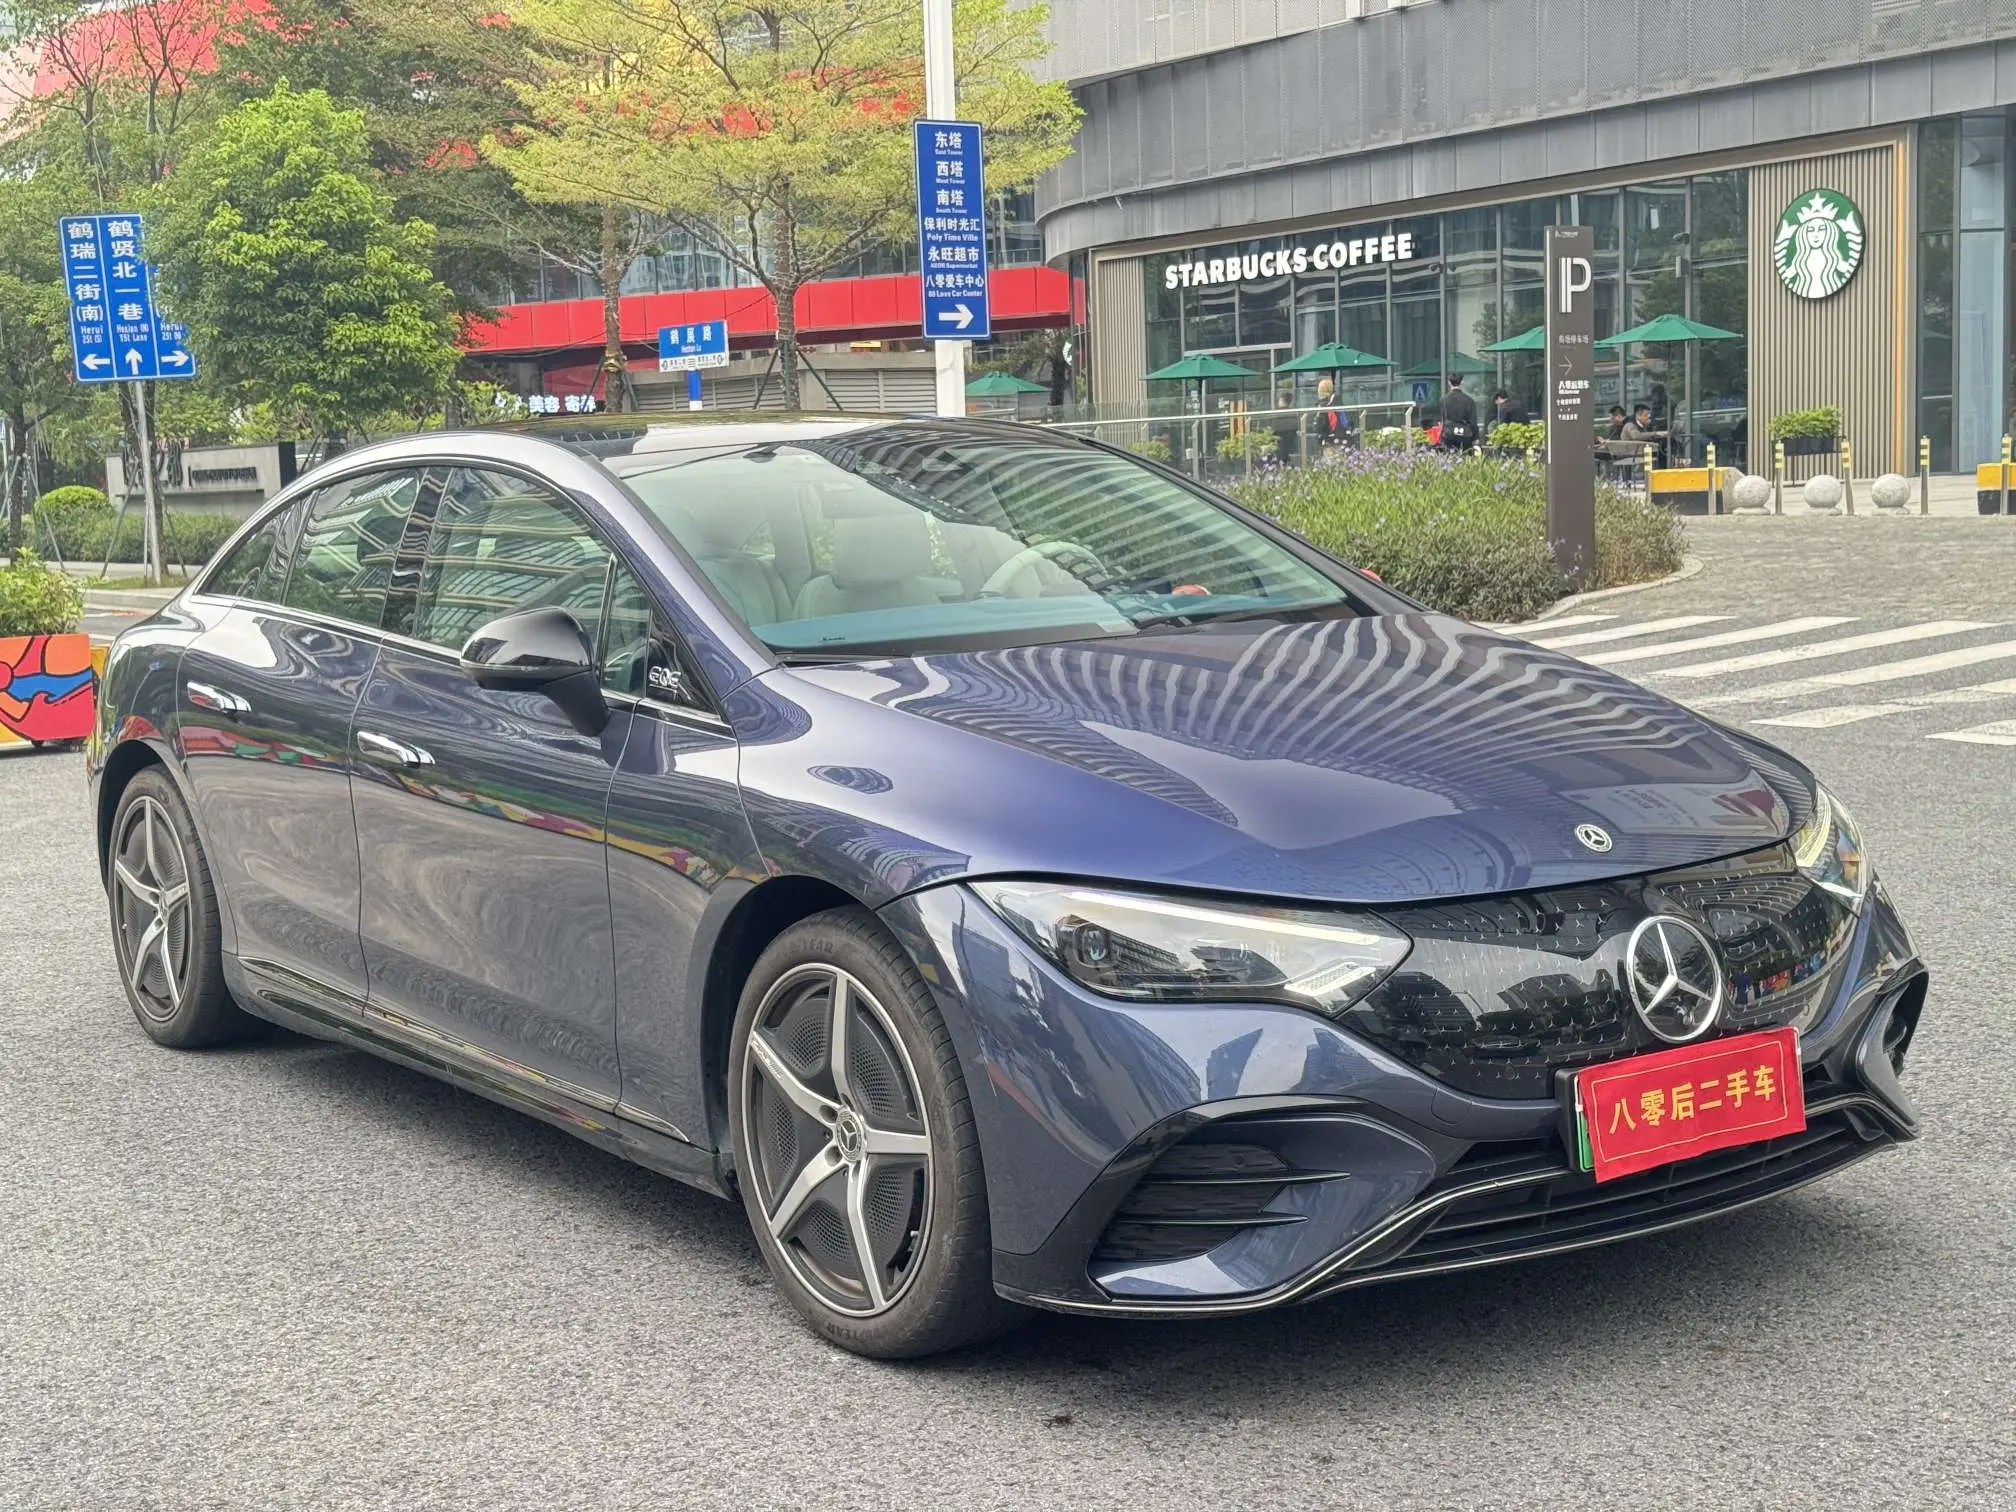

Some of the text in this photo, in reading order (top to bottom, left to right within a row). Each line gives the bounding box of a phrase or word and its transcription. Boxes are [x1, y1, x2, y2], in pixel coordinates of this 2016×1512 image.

[935, 131, 962, 149] 东塔
[936, 161, 963, 178] 西塔
[936, 189, 964, 206] 南塔
[924, 217, 981, 231] 保利时光汇
[926, 233, 979, 243] Poly Time Ville
[928, 246, 980, 262] 永旺超市
[1164, 232, 1413, 290] STARBUCKS COFFEE
[108, 221, 143, 321] 鹤贤北一巷
[926, 273, 985, 289] 八零爱车中心
[80, 325, 104, 335] Herui
[160, 322, 183, 332] Herui
[649, 665, 682, 688] EQE
[1608, 1063, 1777, 1136] 八零后二手车
